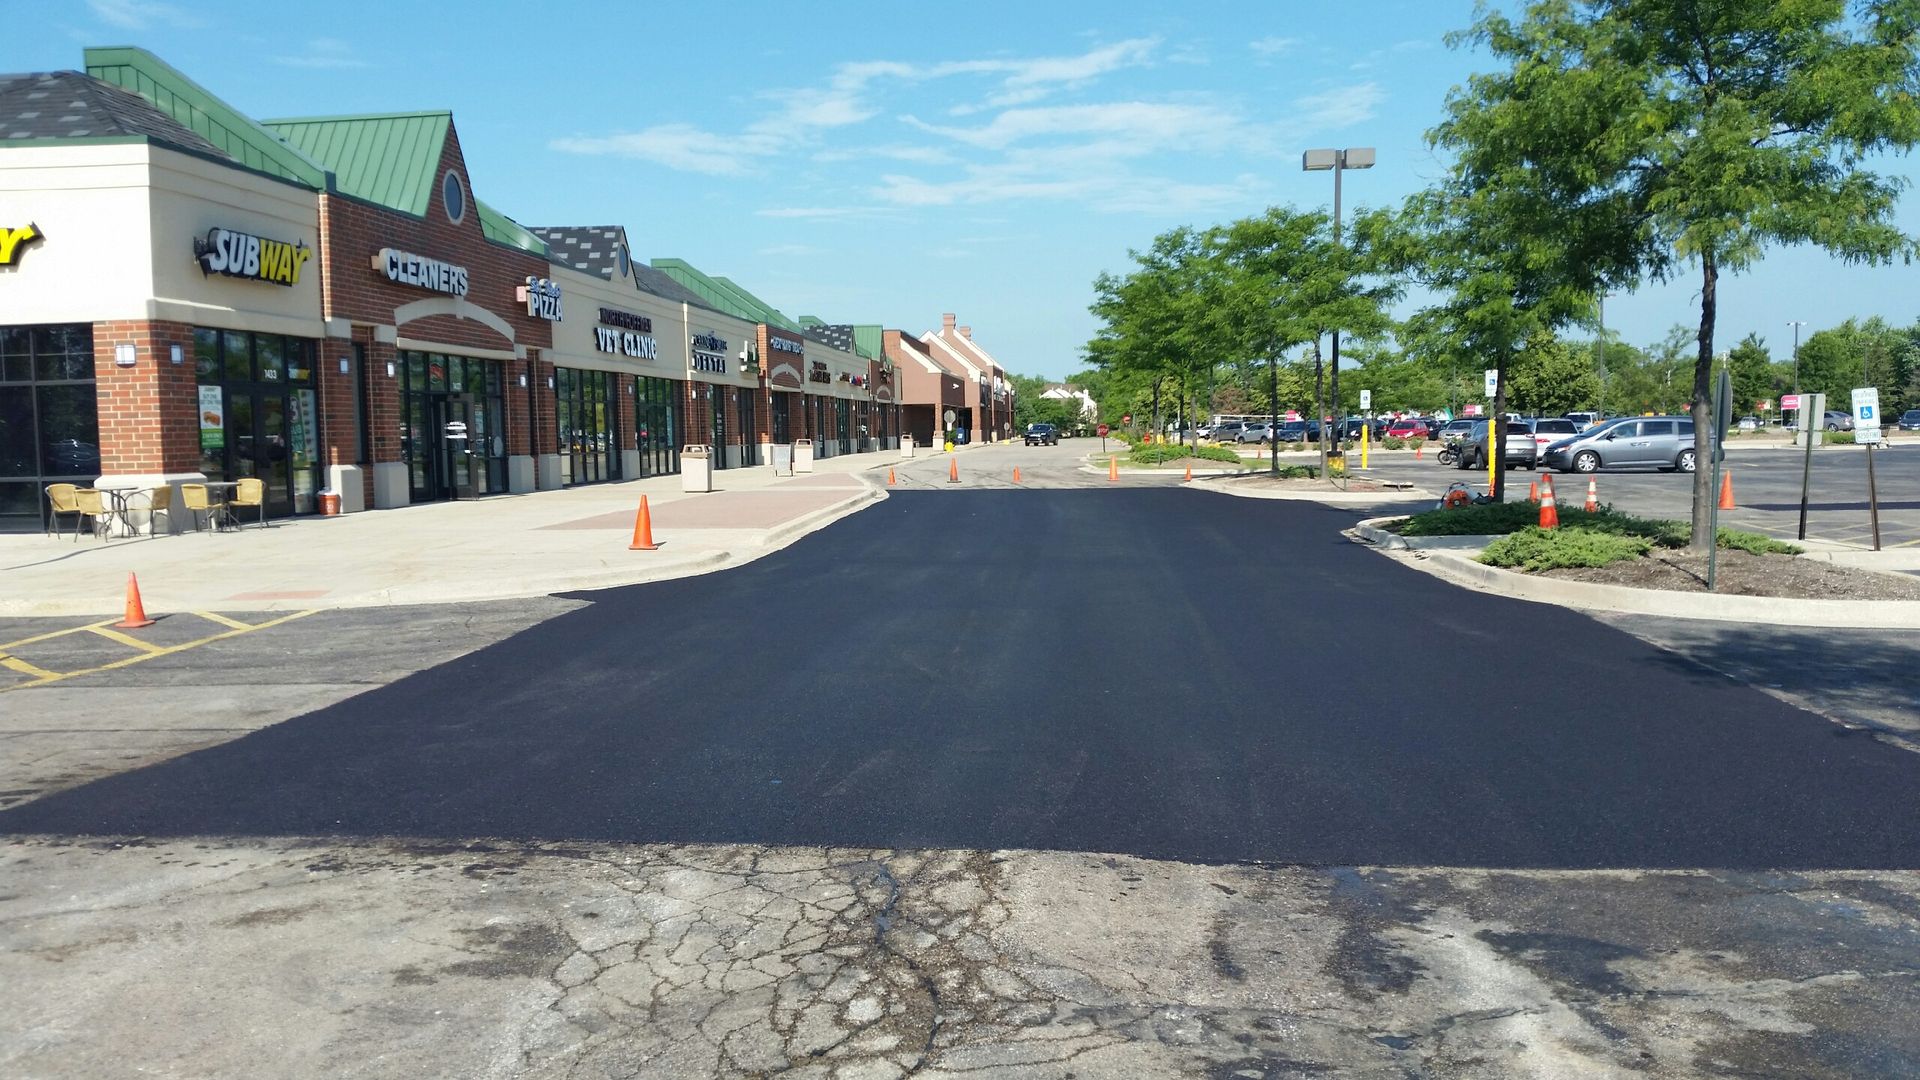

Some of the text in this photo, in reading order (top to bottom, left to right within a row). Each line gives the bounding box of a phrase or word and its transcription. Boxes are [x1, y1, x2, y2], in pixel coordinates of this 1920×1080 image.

[208, 229, 312, 285] SUBWAY
[382, 248, 469, 297] CLEANERS
[529, 292, 564, 321] PIZZA
[596, 327, 657, 360] VET CLINIC
